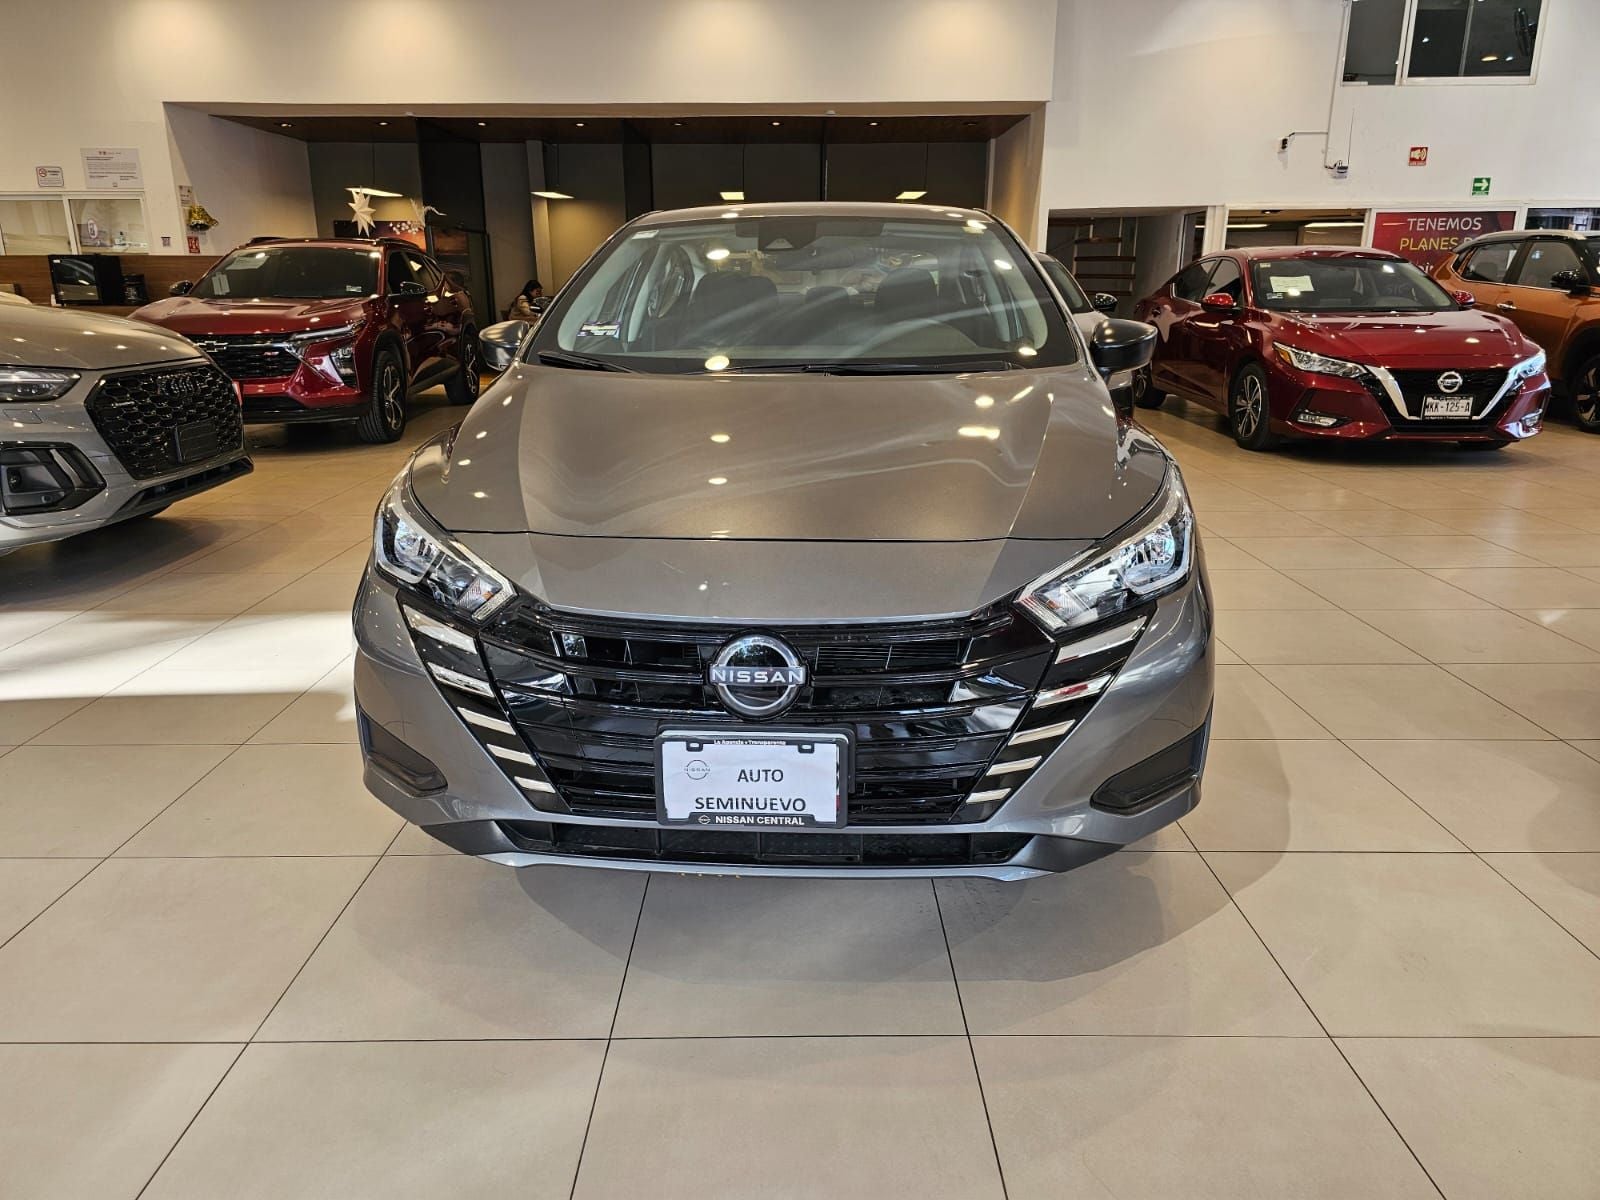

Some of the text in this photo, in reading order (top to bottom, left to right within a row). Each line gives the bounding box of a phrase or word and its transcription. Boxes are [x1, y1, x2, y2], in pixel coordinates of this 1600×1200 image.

[1407, 217, 1482, 231] TENEMOS
[1399, 237, 1459, 250] PLANES
[712, 668, 803, 683] NISSAN
[737, 769, 784, 783] AUTO
[695, 797, 806, 812] SEMINUEVO
[715, 815, 805, 826] NISSAN CENTRAL
